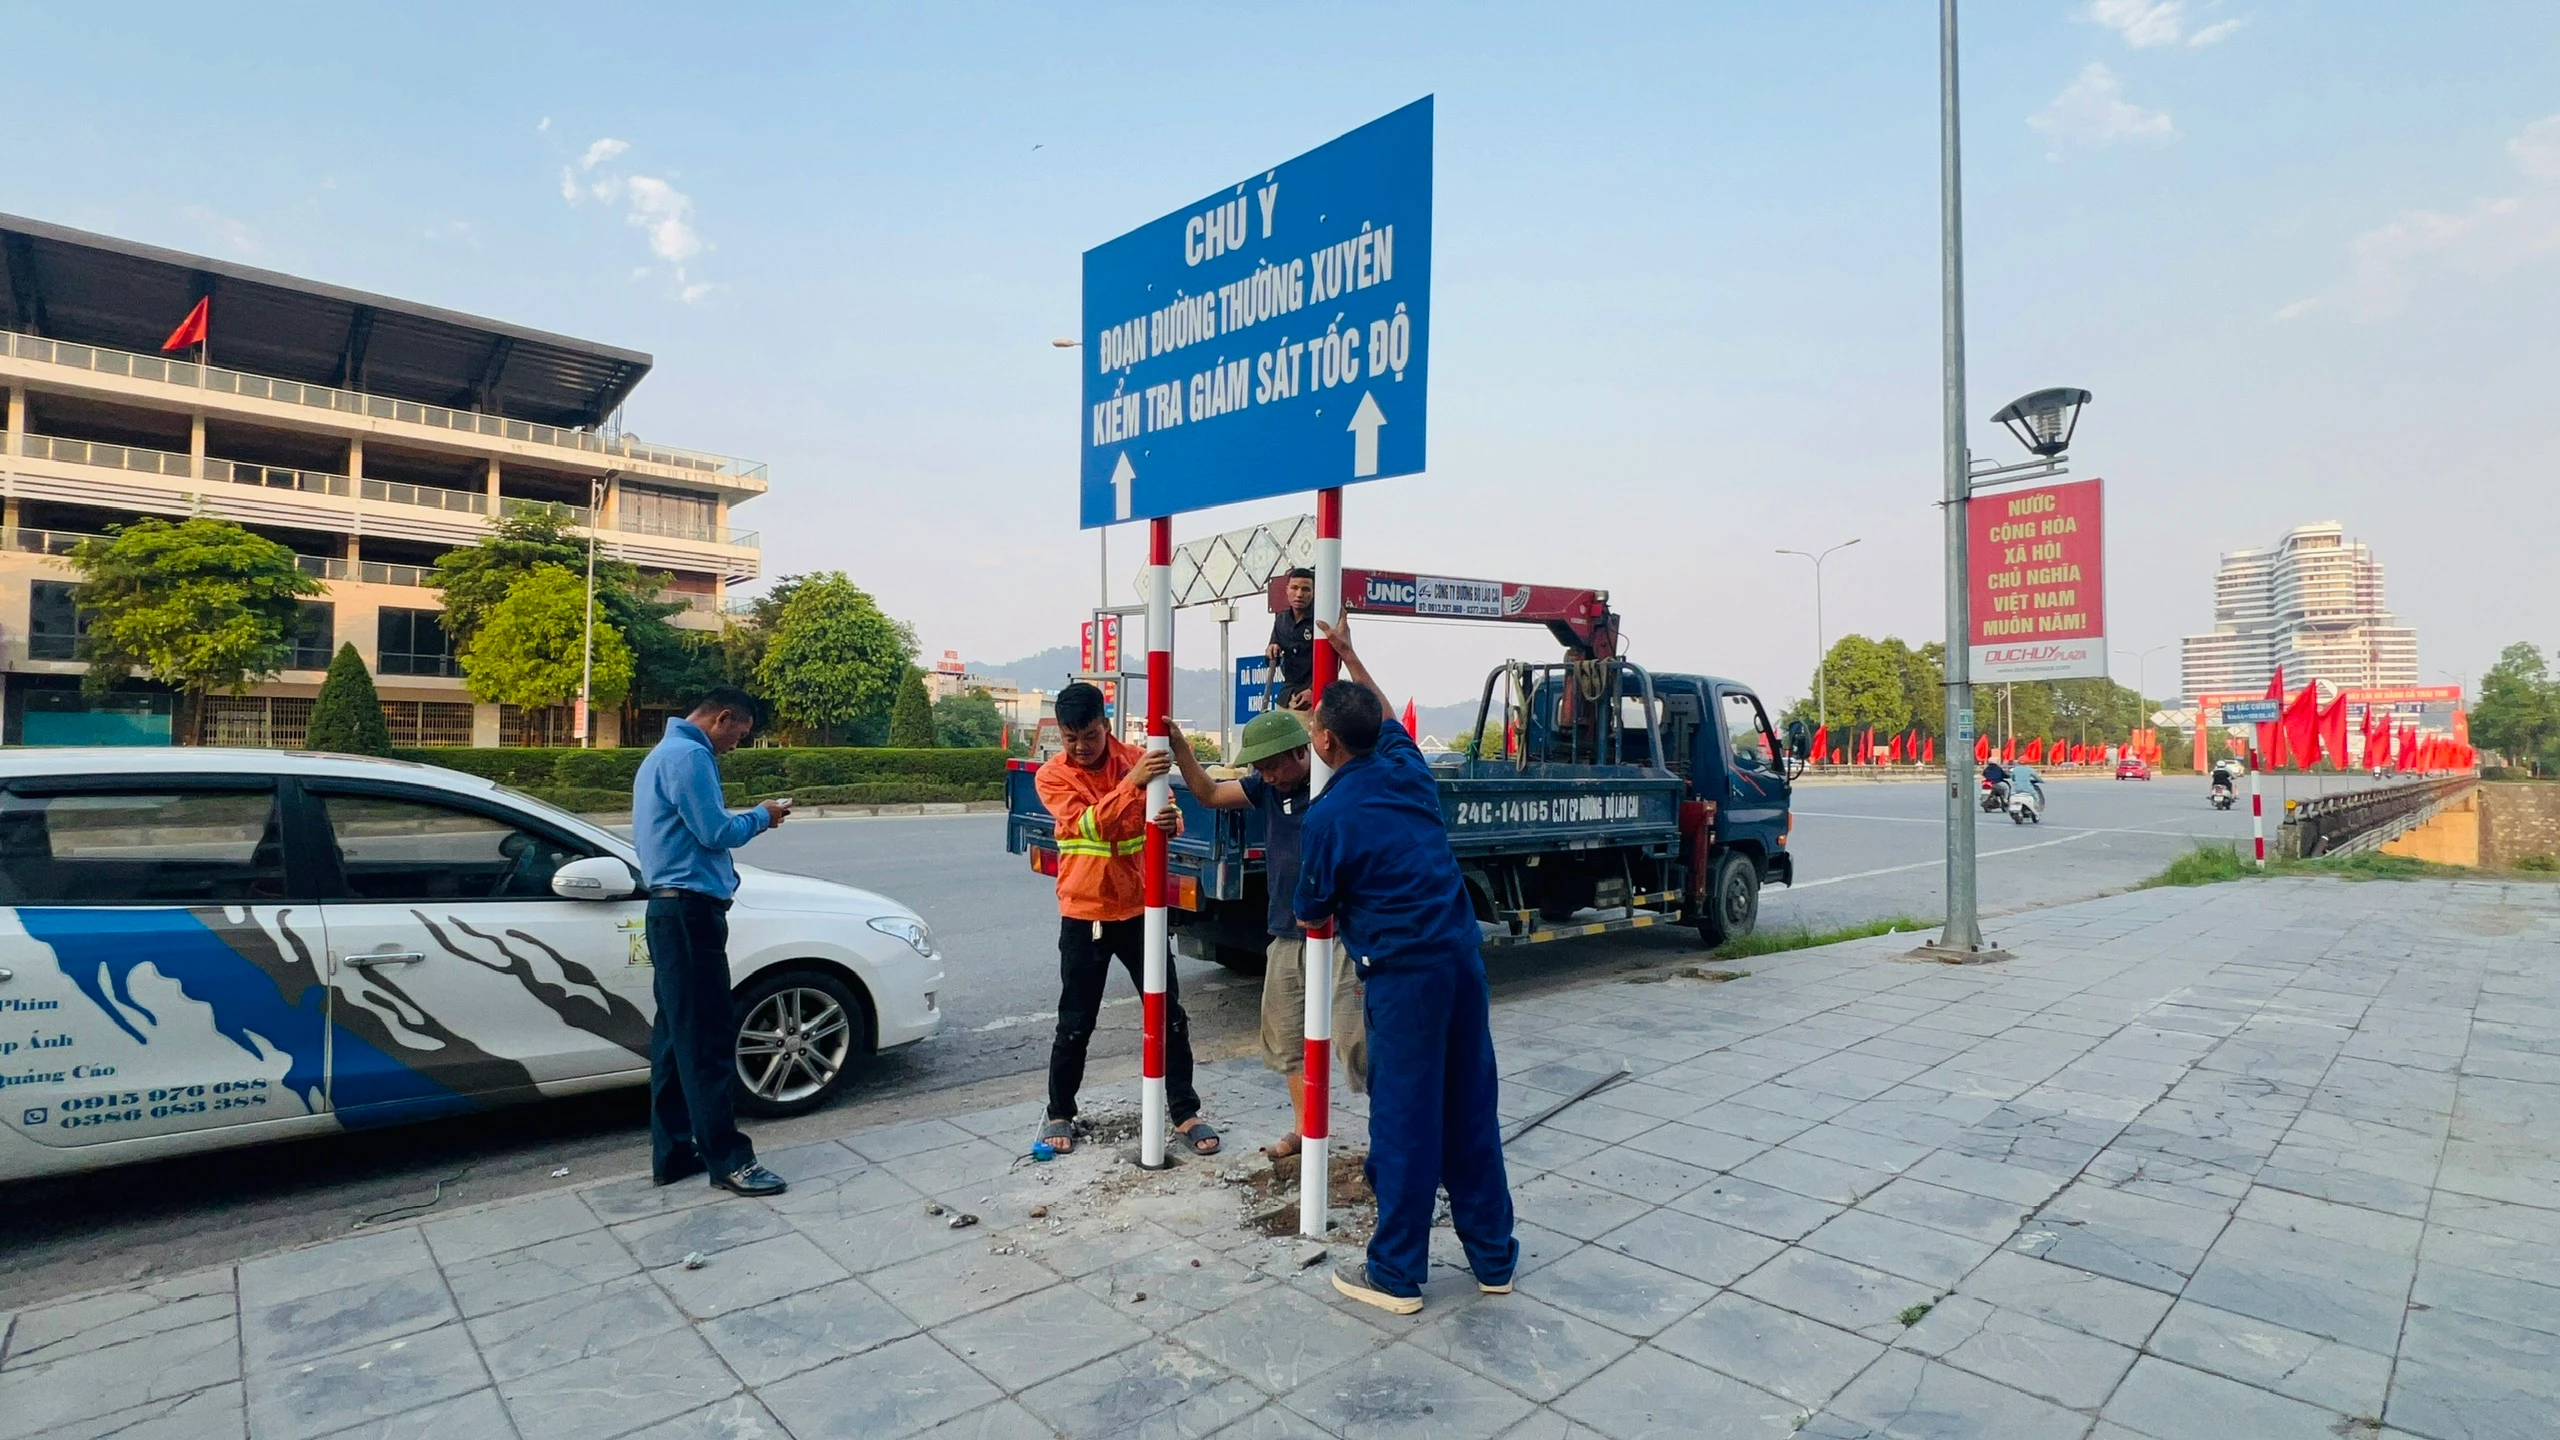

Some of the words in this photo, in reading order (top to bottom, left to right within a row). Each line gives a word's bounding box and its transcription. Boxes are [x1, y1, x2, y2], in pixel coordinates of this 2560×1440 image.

[1185, 183, 1247, 266] CHÚ
[1258, 170, 1279, 238] Ý
[1100, 316, 1147, 376] ĐOẠN
[1151, 289, 1215, 357] ĐƯỜNG
[1219, 258, 1303, 335] THƯỜNG
[1310, 221, 1394, 303] XUYÊN
[1093, 379, 1140, 447] KIỂM
[1146, 380, 1183, 432] TRA
[1189, 356, 1249, 423] GIÁM
[1256, 337, 1304, 404] SÁT
[1308, 313, 1360, 392] TỐC
[1368, 302, 1411, 382] ĐỘ
[2008, 493, 2056, 517] NƯỚC
[1989, 522, 2036, 544] CỘNG
[2041, 514, 2077, 536] HÒA
[2004, 545, 2028, 565] XÃ
[2032, 540, 2061, 563] HỘI
[1988, 567, 2021, 590] CHỦ
[2026, 562, 2081, 586] NGHĨA
[1366, 582, 1415, 603] UNIC
[1434, 581, 1449, 600] CÔNG
[1993, 591, 2029, 613] VIỆT
[2034, 589, 2075, 609] NAM
[1983, 613, 2034, 637] MUÔN
[2038, 611, 2087, 633] NĂM!
[1457, 800, 1549, 824] 24C-14165
[0, 998, 58, 1013] Phim
[25, 1029, 73, 1049] Ảnh
[72, 1063, 115, 1079] Cáo
[61, 1093, 139, 1112] 0915
[213, 1078, 267, 1094] 688
[60, 1109, 142, 1129] 0386
[150, 1101, 206, 1118] 683
[213, 1094, 267, 1110] 388
